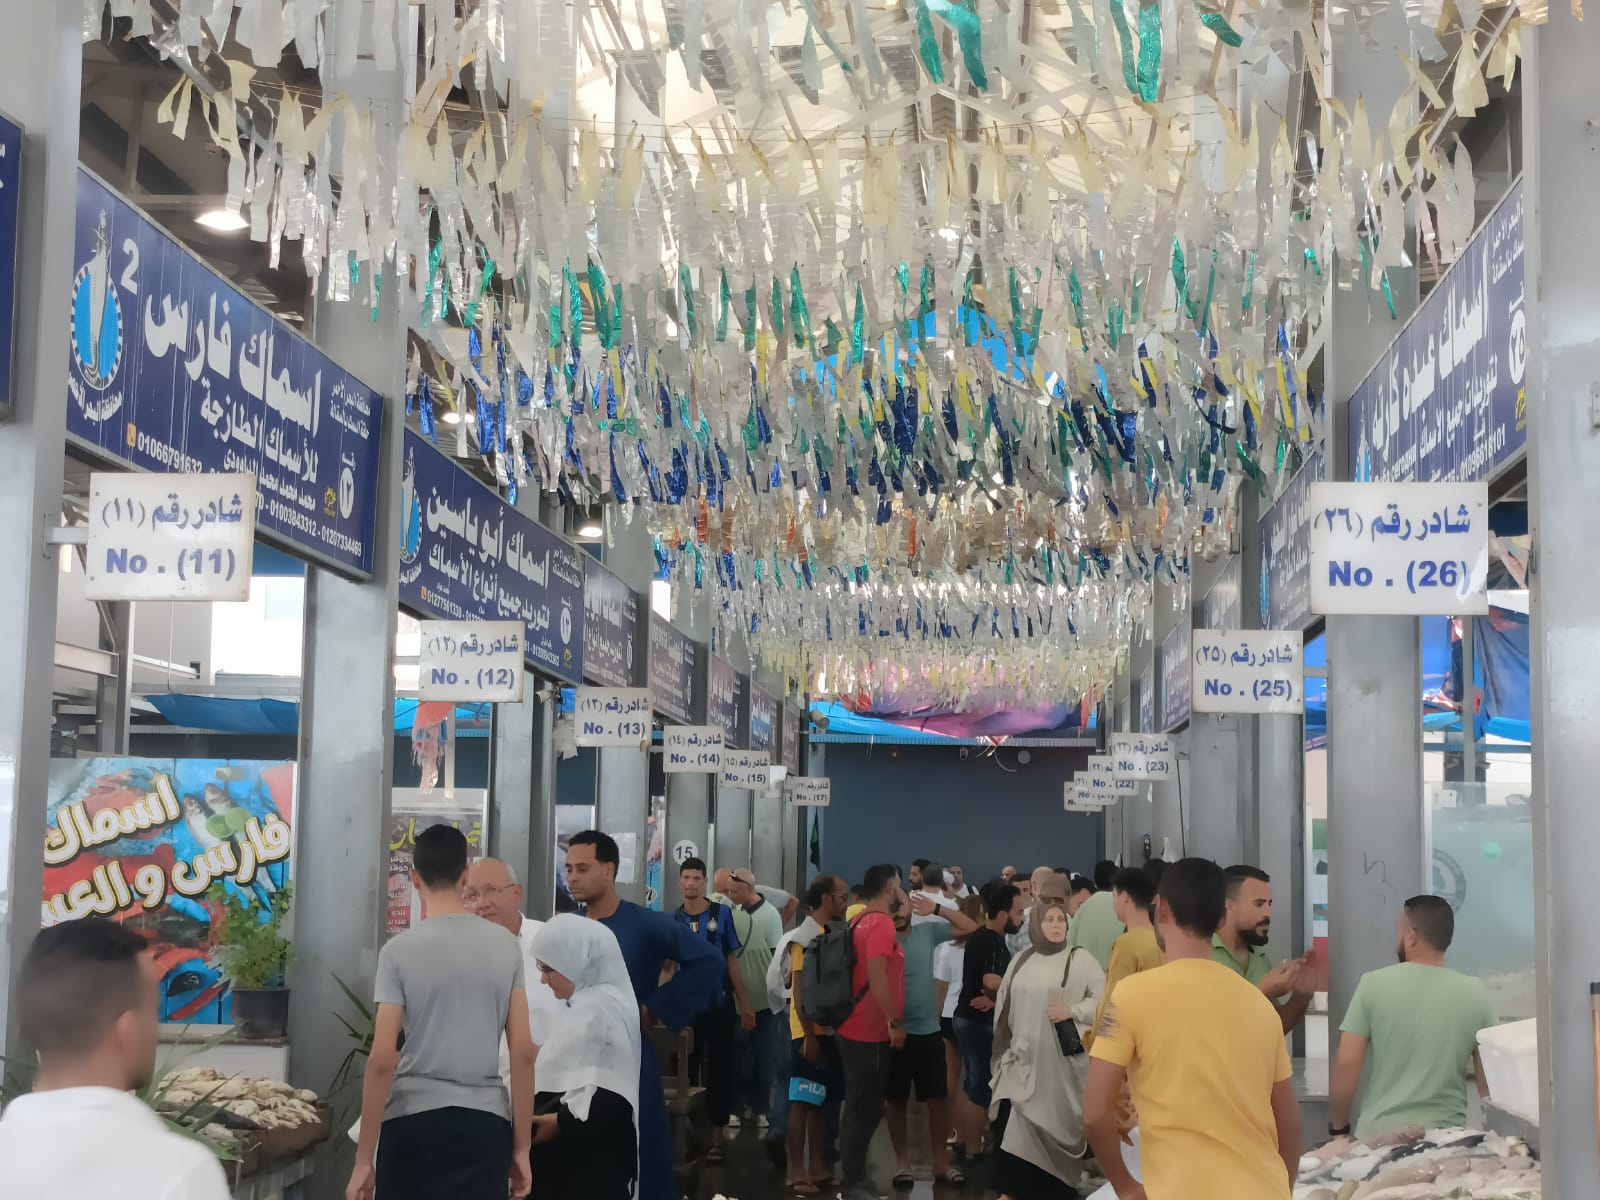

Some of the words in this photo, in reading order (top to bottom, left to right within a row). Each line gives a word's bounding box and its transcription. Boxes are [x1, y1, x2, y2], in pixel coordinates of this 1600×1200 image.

[121, 238, 140, 296] 2
[1438, 241, 1489, 381] اسماك
[145, 292, 232, 382] فارس
[239, 328, 322, 438] اسماك
[1403, 333, 1436, 425] عبده
[201, 376, 264, 452] الطازجة
[265, 427, 319, 485] للأسماك
[151, 493, 190, 532] رقم
[192, 493, 243, 530] شادر
[426, 486, 479, 557] ياسين
[1371, 503, 1412, 543] رقم
[1414, 503, 1471, 541] شادر
[479, 505, 505, 568] أبو
[177, 548, 236, 582] (11)
[505, 530, 550, 591] اسماك
[1406, 560, 1471, 595] (26)
[497, 583, 522, 619] جميع
[460, 633, 485, 658] رقم
[486, 633, 519, 657] شادر
[1230, 643, 1256, 669] رقم
[1258, 643, 1293, 667] شادر
[477, 668, 515, 687] (12)
[1252, 679, 1293, 701] (25)
[605, 697, 624, 715] رقم
[617, 722, 646, 738] (13)
[687, 733, 702, 747] رقم
[697, 753, 721, 766] (14)
[726, 757, 738, 767] ١٥)
[1145, 761, 1169, 774] (23)
[747, 773, 767, 785] (15)
[43, 774, 181, 864] اسماك
[172, 813, 292, 896] فارس
[675, 845, 693, 860] 15
[134, 864, 166, 908] و
